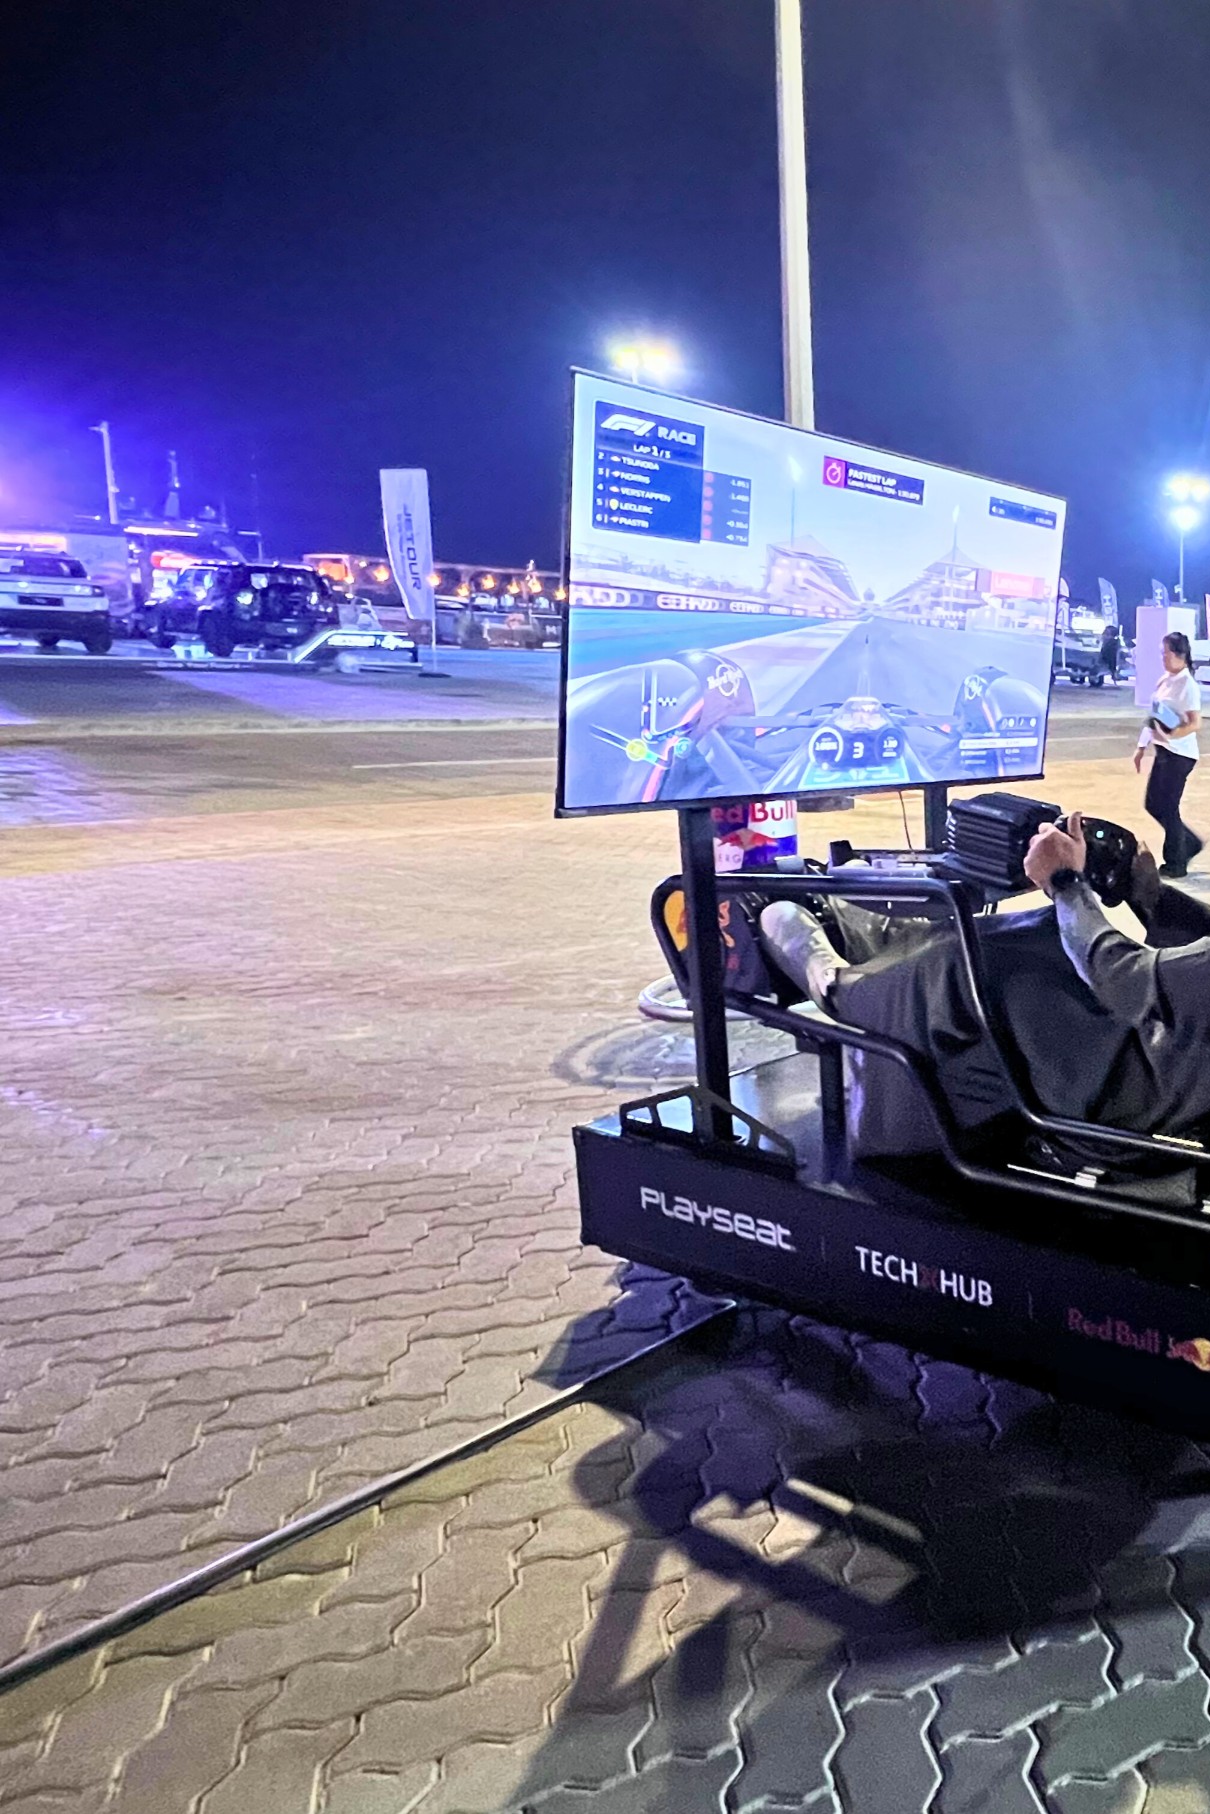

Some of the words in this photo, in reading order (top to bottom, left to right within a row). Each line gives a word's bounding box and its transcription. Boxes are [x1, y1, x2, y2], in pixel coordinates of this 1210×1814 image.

[657, 426, 697, 446] RACE
[633, 444, 651, 454] LAP
[848, 468, 882, 484] FASTEST
[882, 476, 897, 487] LAP
[402, 503, 422, 591] JETOUR
[852, 741, 865, 759] 3
[710, 804, 744, 823] ed
[751, 799, 794, 823] Bull
[1067, 1307, 1112, 1341] Red
[1115, 1320, 1160, 1354] Bull
